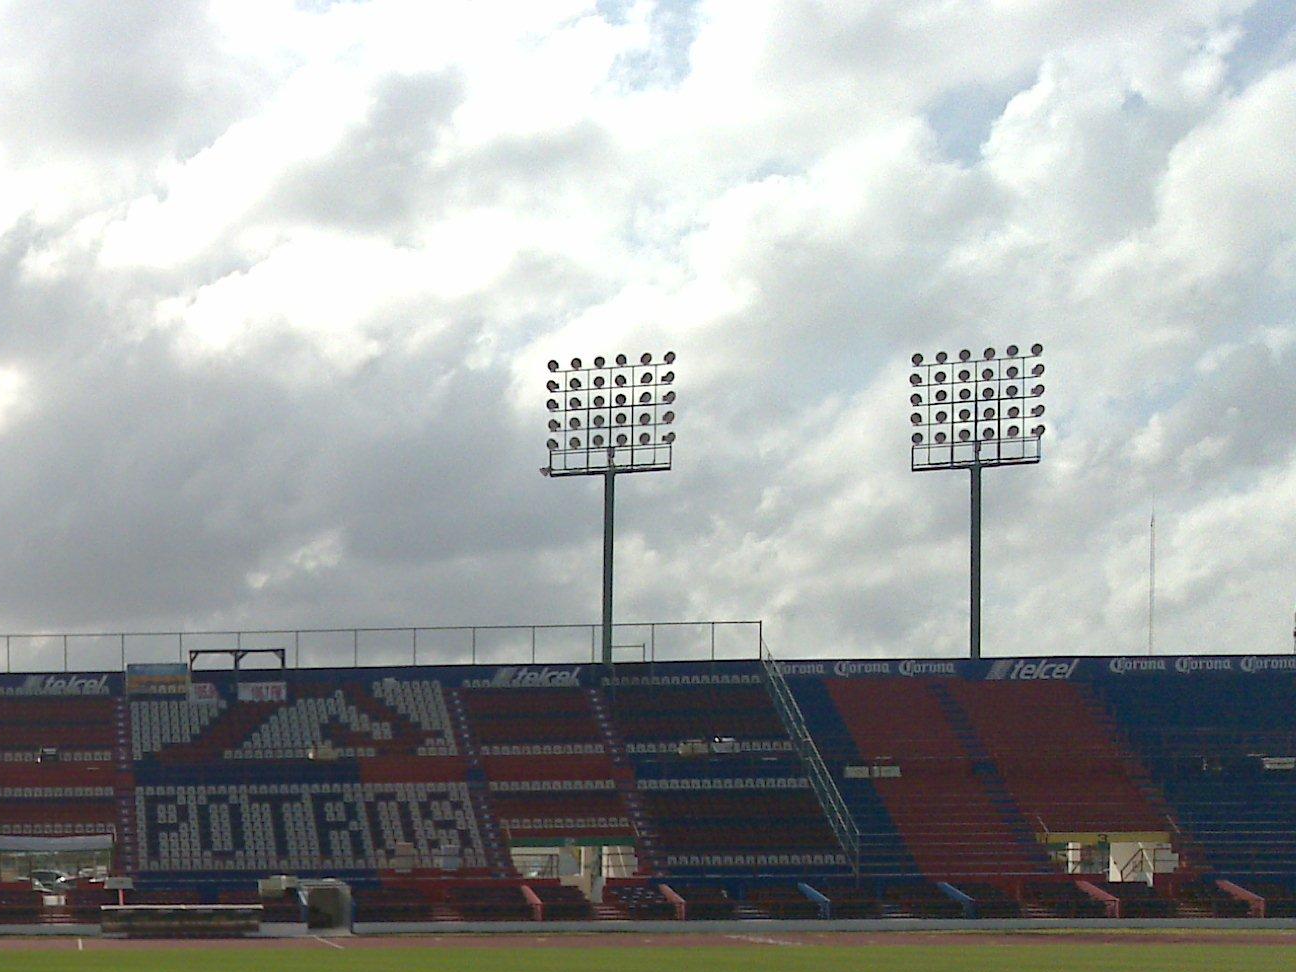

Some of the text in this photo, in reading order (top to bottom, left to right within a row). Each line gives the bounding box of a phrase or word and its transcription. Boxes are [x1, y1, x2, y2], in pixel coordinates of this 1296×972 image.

[834, 660, 889, 677] Corona
[898, 659, 955, 676] Corona
[1009, 658, 1080, 680] telcel
[1109, 656, 1167, 674] Corona
[1175, 656, 1232, 674] Corona
[1240, 655, 1296, 673] Corona
[44, 675, 108, 695] telcel
[511, 666, 581, 687] telcel
[146, 791, 476, 862] POTROS
